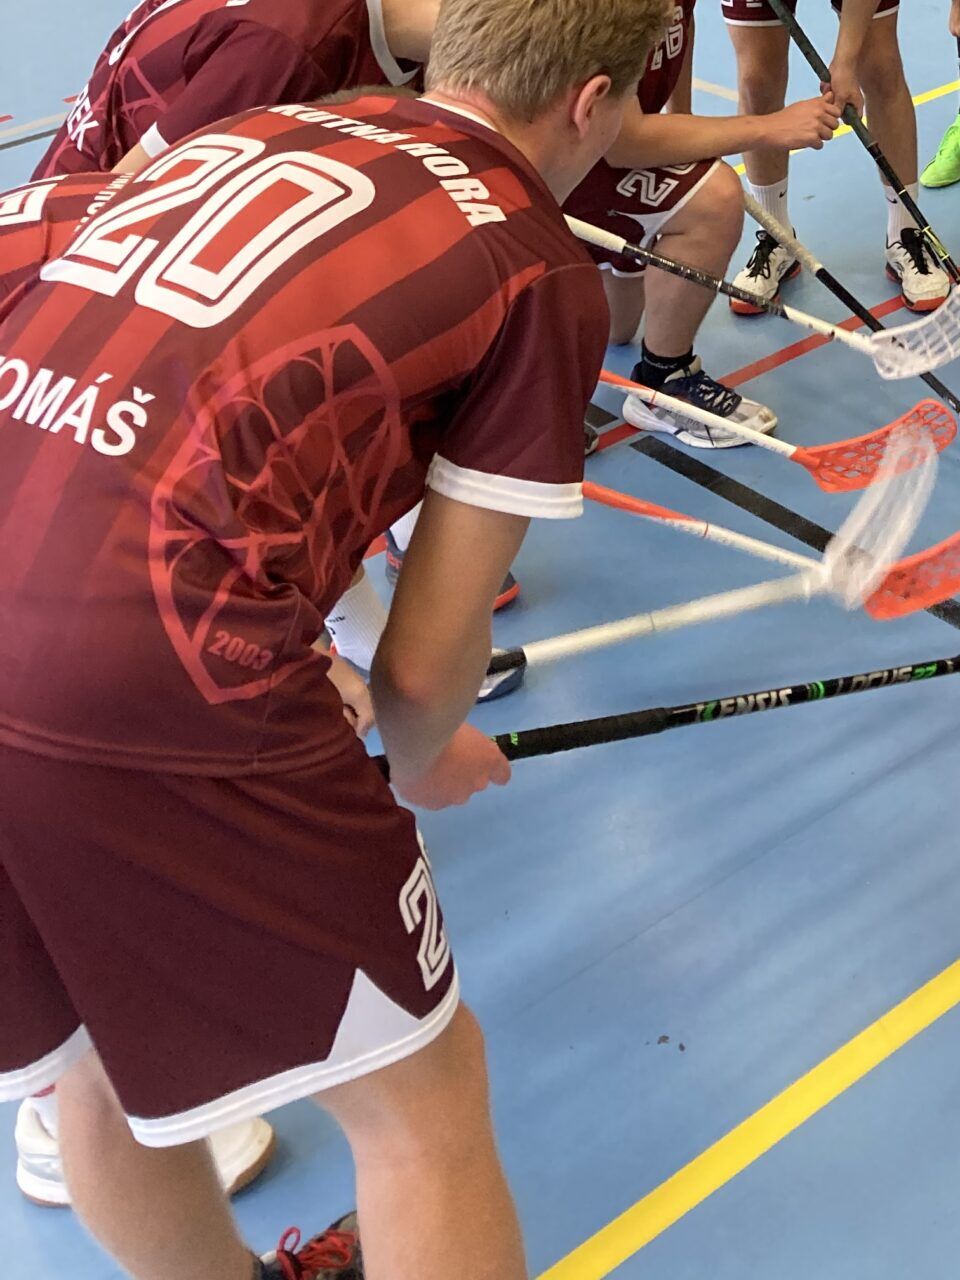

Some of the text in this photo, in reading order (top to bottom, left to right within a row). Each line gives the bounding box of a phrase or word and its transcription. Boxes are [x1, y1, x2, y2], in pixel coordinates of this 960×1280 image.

[267, 104, 508, 228] KUTNÁ HORA
[41, 133, 376, 328] 20
[0, 355, 156, 456] OMÁŠ
[207, 631, 274, 670] 2003
